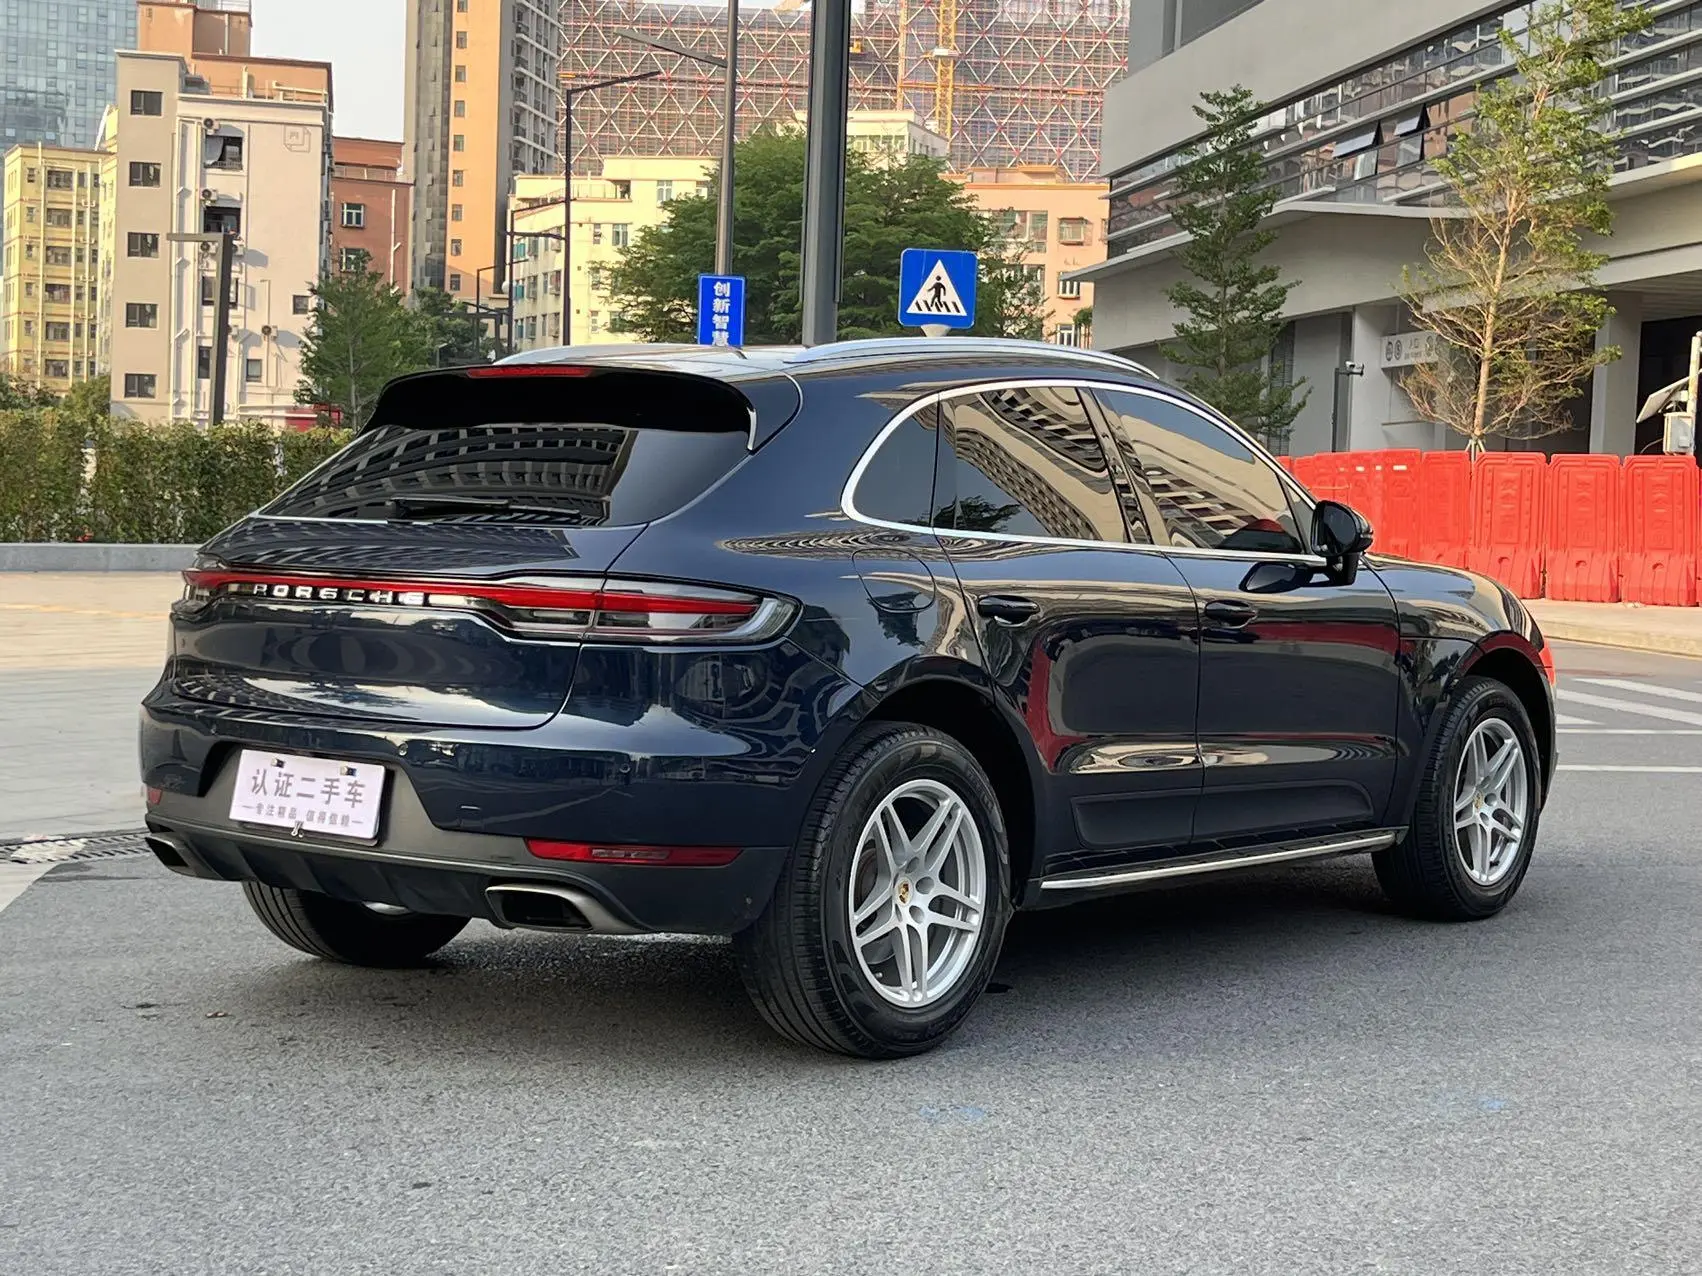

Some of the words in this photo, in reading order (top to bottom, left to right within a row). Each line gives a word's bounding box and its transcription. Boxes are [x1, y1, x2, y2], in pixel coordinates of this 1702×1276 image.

[253, 584, 424, 605] PORSCHE
[251, 768, 365, 808] 认证二手车
